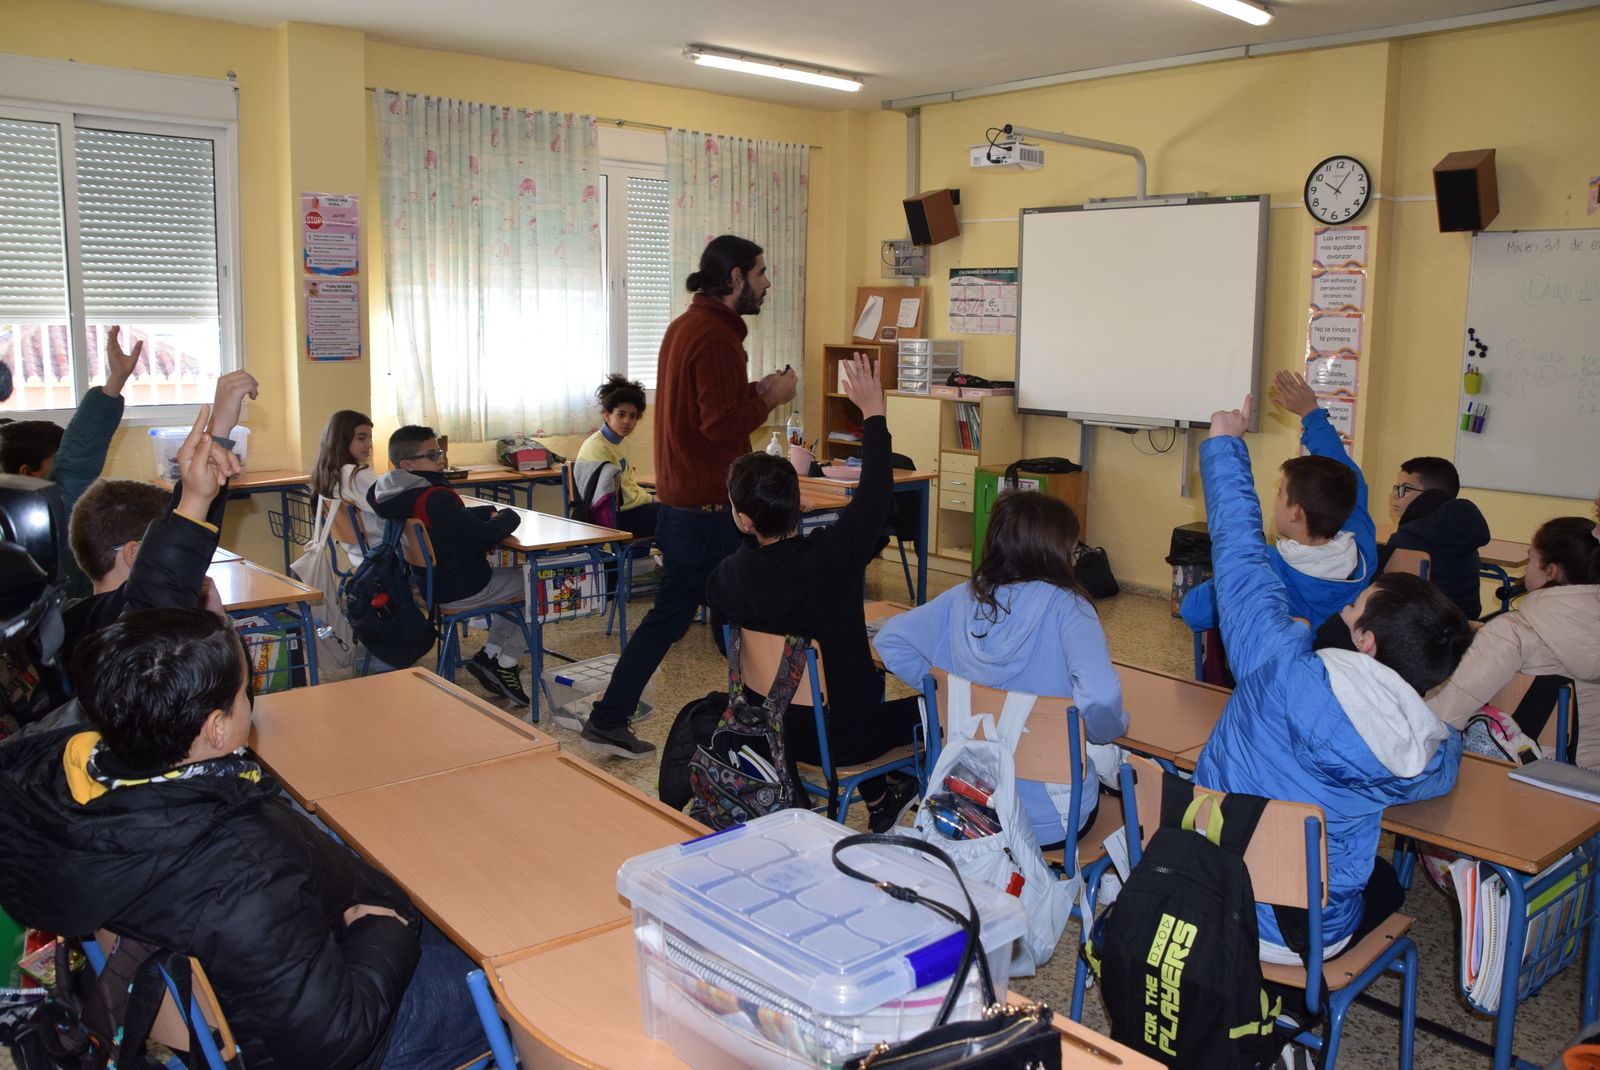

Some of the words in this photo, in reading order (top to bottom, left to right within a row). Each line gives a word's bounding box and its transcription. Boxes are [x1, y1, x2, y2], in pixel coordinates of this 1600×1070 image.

[1337, 161, 1344, 169] 12
[1315, 174, 1323, 182] 10
[1357, 173, 1365, 182] 2
[1311, 186, 1317, 195] 9
[1359, 186, 1366, 195] 3
[1313, 198, 1319, 207] 8
[1353, 198, 1361, 207] 4
[1321, 208, 1327, 216] 7
[1330, 211, 1338, 220] 6
[1344, 208, 1351, 217] 5
[306, 216, 322, 225] STOP
[1332, 244, 1356, 252] ayudan
[1569, 238, 1584, 252] de
[1146, 974, 1158, 1006] THE
[1159, 920, 1197, 1056] PLAYERS
[1145, 1012, 1157, 1045] FOR
